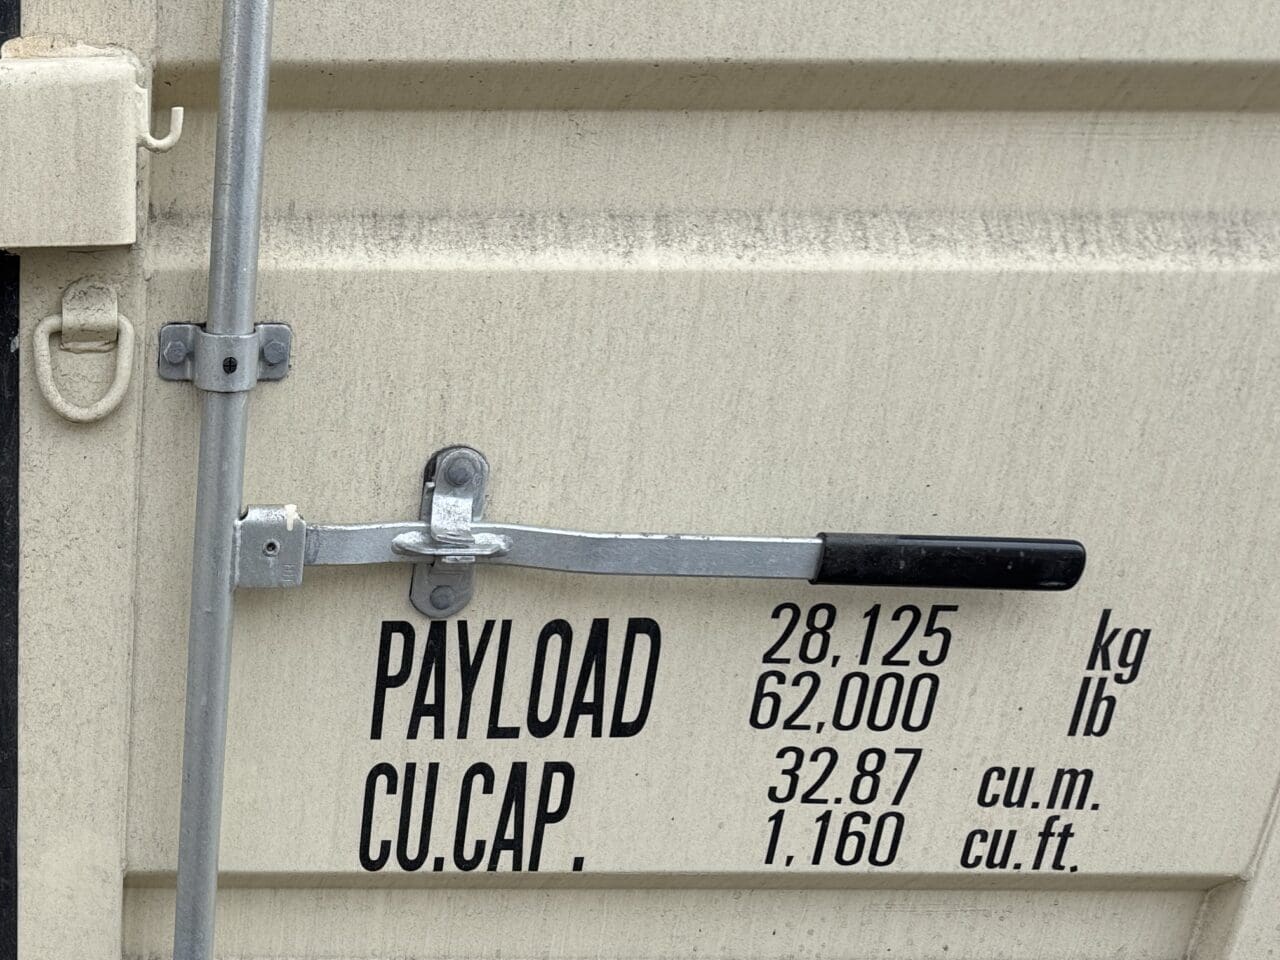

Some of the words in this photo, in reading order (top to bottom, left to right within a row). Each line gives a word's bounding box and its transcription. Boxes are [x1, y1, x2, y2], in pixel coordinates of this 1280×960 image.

[370, 616, 662, 740] PAYLOAD
[761, 602, 959, 668] 28,125
[1085, 608, 1151, 684] kg
[749, 670, 940, 734] 62,000
[1067, 677, 1117, 737] lb
[359, 761, 585, 873] CU.CAP.
[767, 746, 923, 806] 32.87
[977, 766, 1100, 811] cu.m.
[764, 809, 905, 867] 1,160
[960, 815, 1078, 873] cu.ft.
